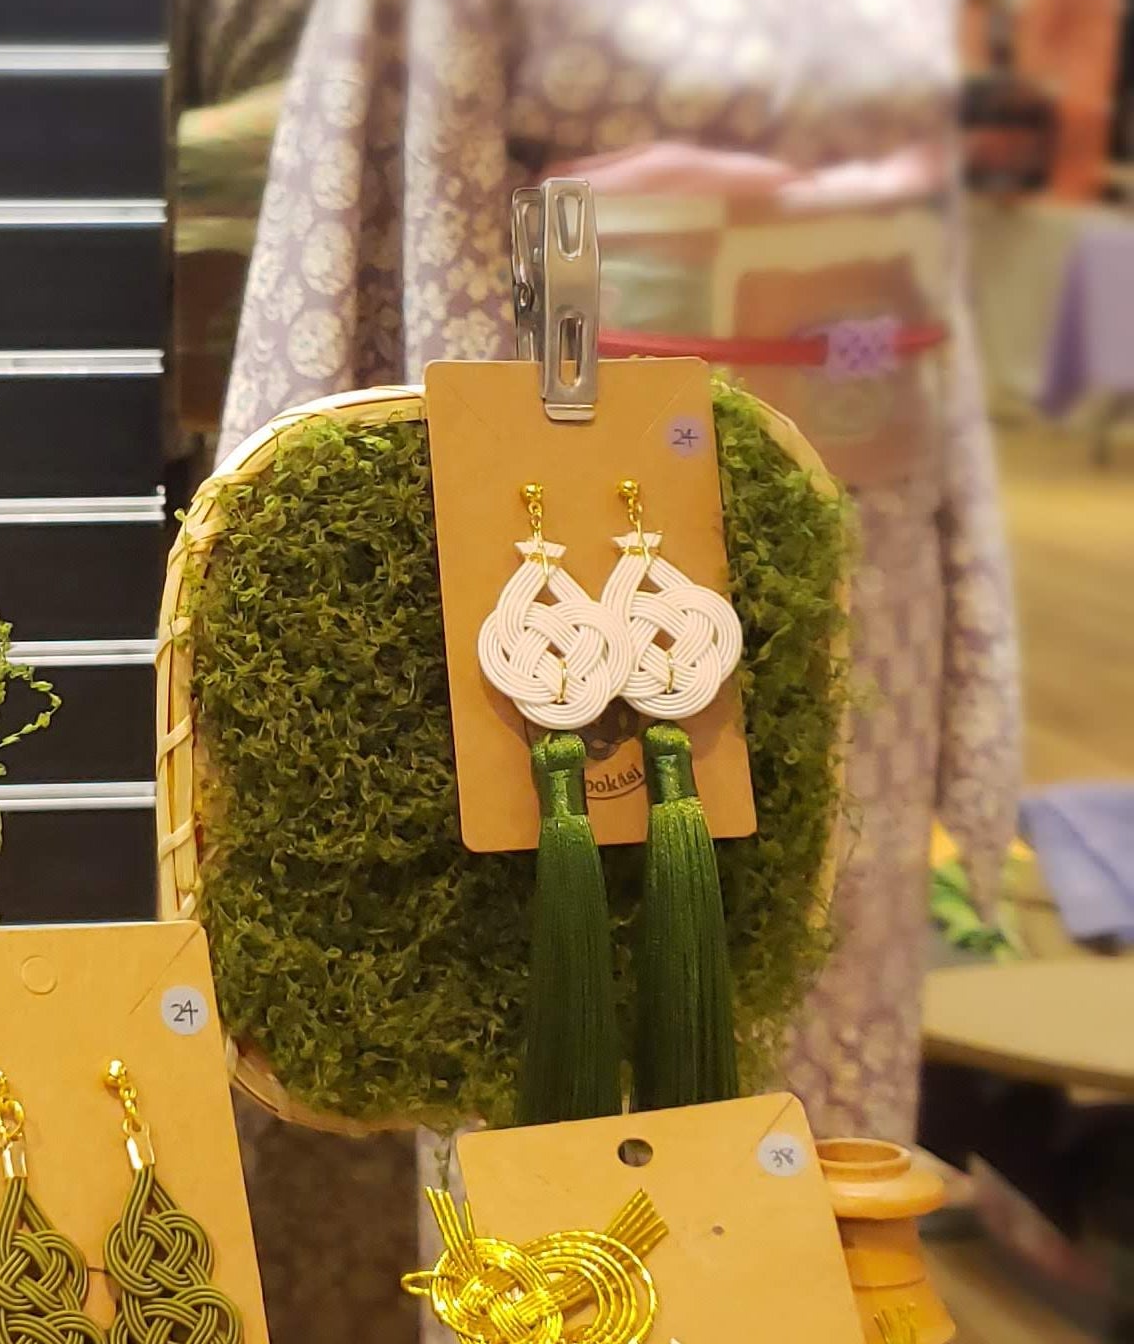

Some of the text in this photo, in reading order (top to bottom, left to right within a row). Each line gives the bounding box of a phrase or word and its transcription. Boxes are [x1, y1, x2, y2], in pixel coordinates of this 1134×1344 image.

[671, 427, 699, 449] 24
[170, 999, 199, 1026] 24
[769, 1147, 794, 1168] 38
